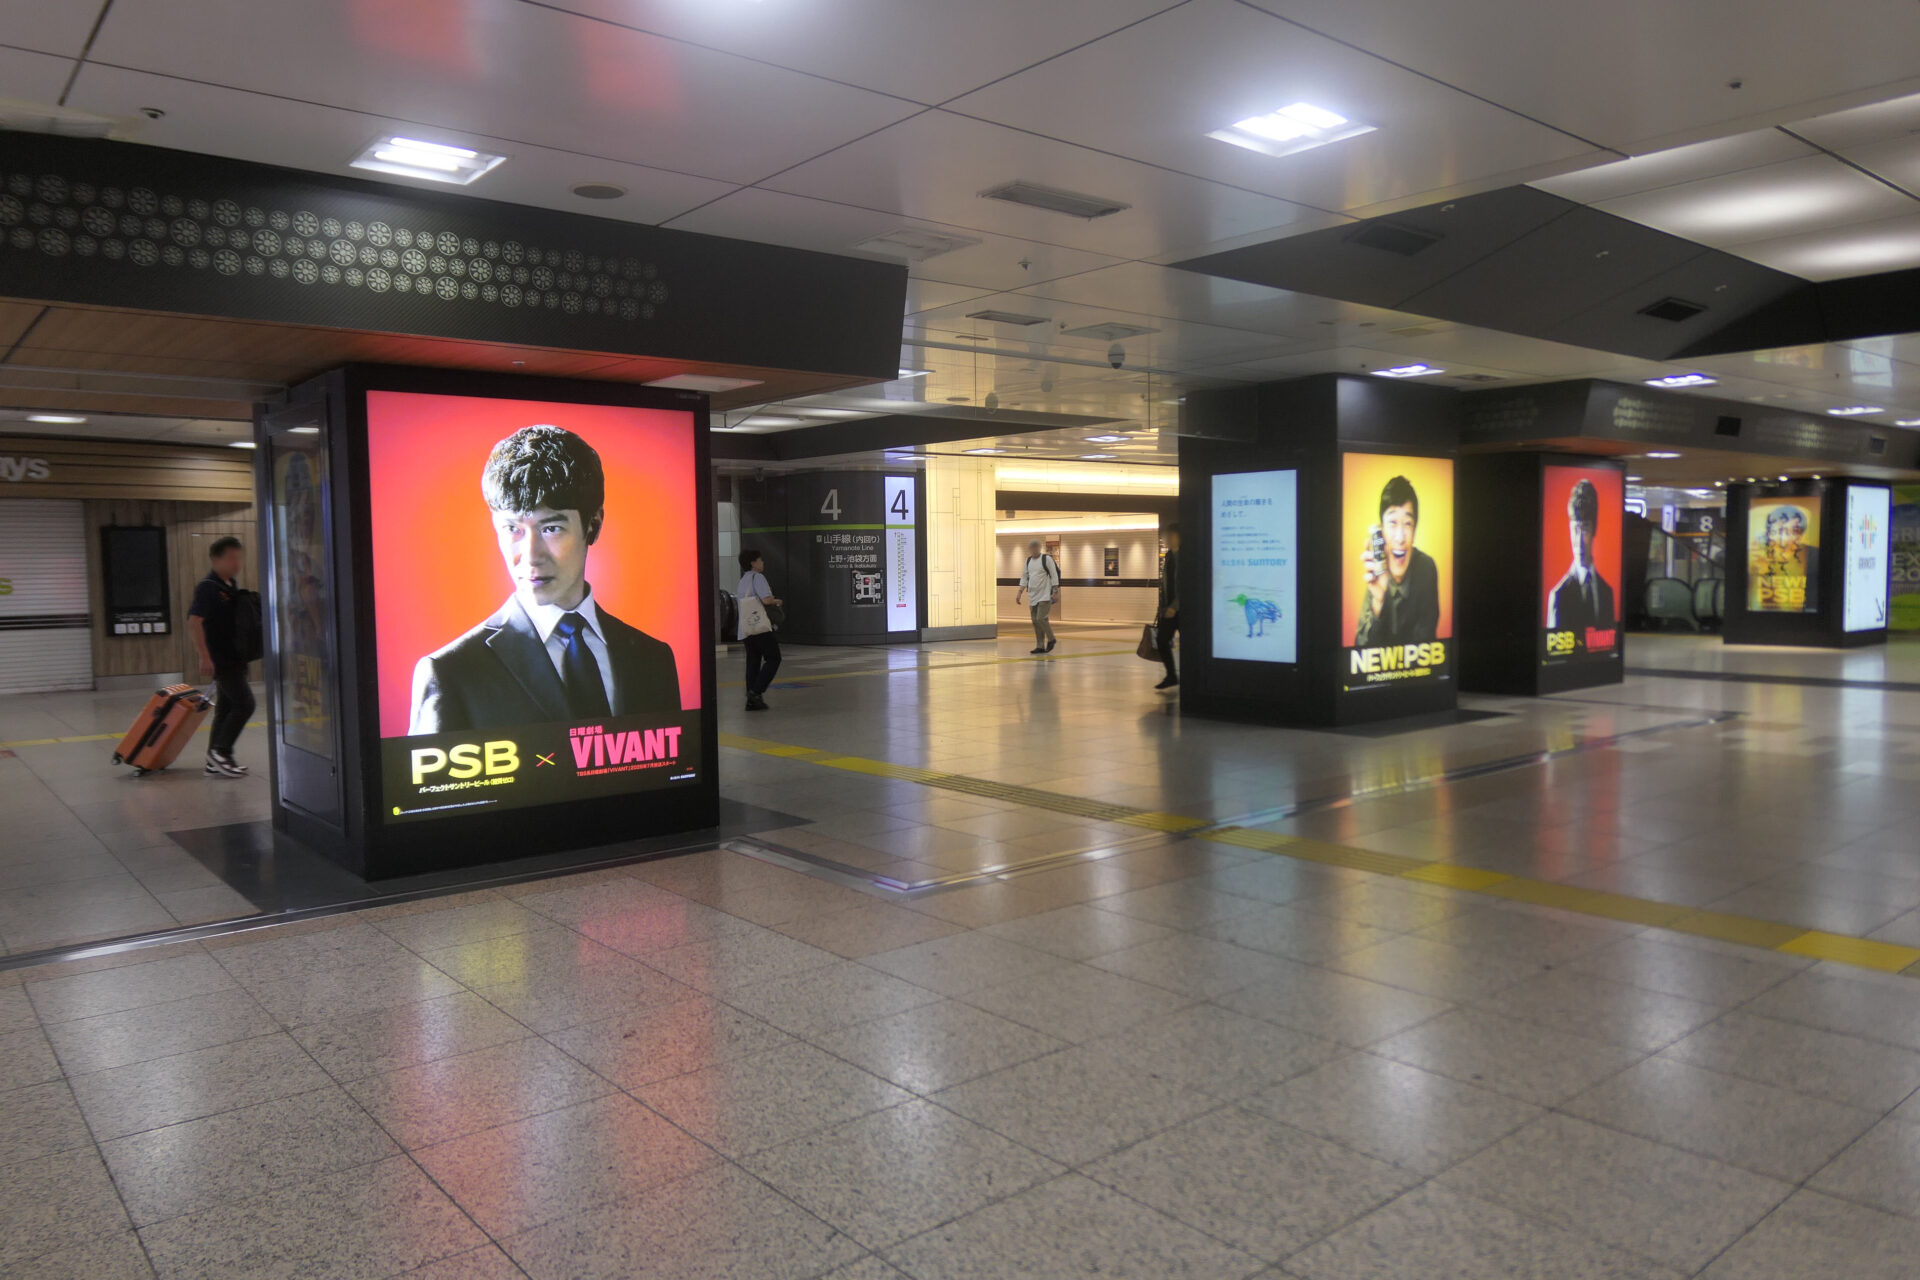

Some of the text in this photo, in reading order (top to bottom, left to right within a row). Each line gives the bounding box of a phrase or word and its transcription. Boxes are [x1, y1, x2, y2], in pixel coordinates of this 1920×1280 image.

[820, 488, 842, 521] 4
[890, 489, 909, 520] 4
[1700, 515, 1713, 532] 8
[1247, 558, 1288, 568] SUNTORY
[1757, 575, 1807, 589] NEW!
[1757, 588, 1806, 605] PSB
[1546, 631, 1575, 652] PSB
[569, 726, 682, 769] VIVANT
[411, 740, 520, 785] PSB
